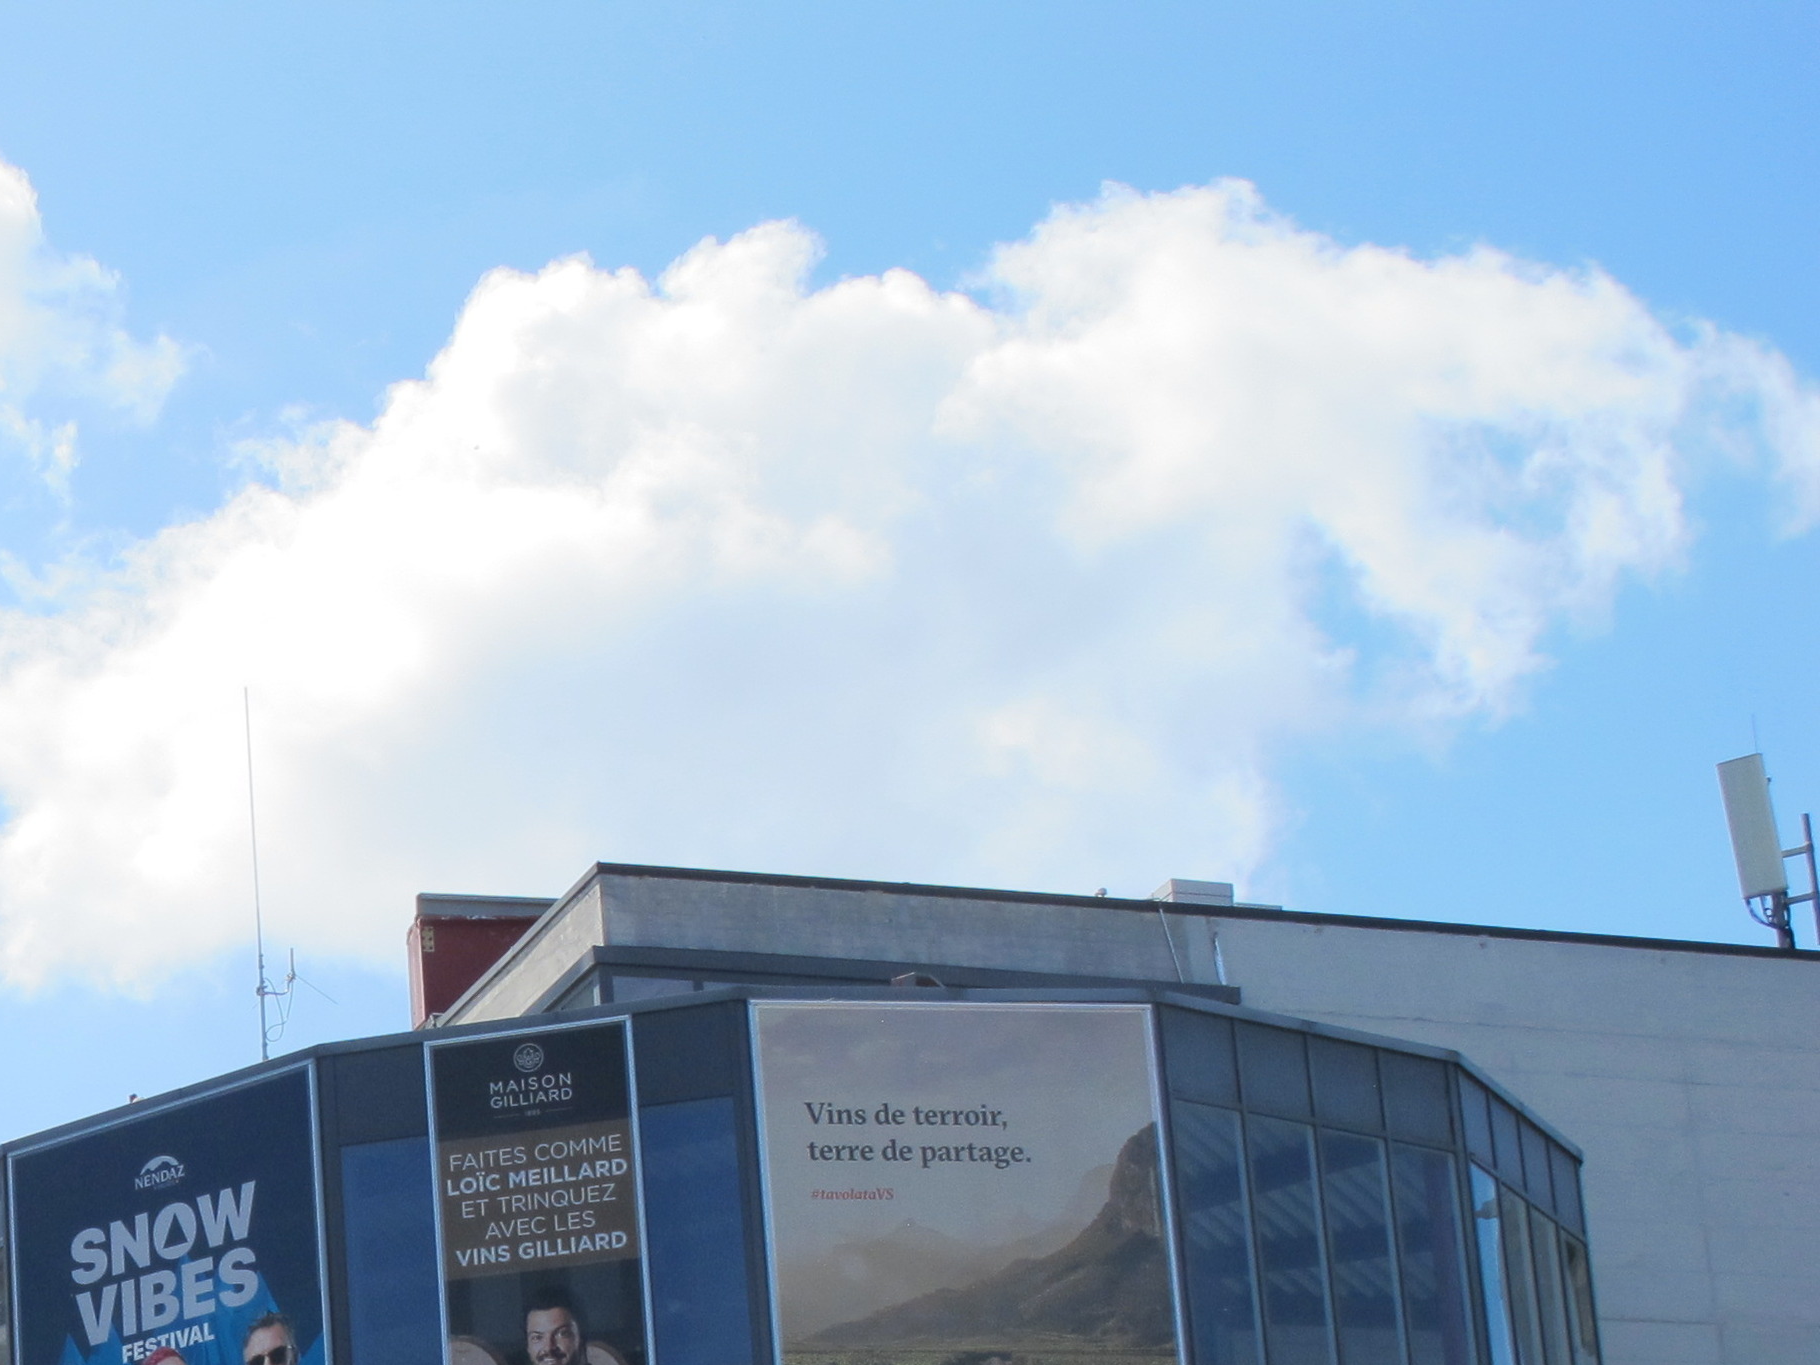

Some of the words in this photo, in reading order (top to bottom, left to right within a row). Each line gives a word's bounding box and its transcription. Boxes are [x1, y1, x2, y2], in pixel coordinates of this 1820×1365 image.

[490, 1072, 572, 1095] MAISON
[490, 1087, 573, 1109] GILLIARD
[804, 1102, 867, 1126] Vins
[874, 1102, 905, 1126] de
[912, 1104, 1008, 1131] terroir,
[449, 1147, 527, 1173] FAITES
[534, 1134, 622, 1162] COMME
[807, 1140, 874, 1162] terre
[881, 1138, 913, 1162] de
[919, 1141, 1032, 1170] partage.
[134, 1164, 185, 1190] NENDAZ
[447, 1172, 500, 1197] LOÏC
[509, 1158, 627, 1189] MEILLARD
[461, 1199, 489, 1219] ET
[497, 1183, 616, 1214] TRINQUEZ
[70, 1180, 256, 1285] SNOW
[485, 1216, 546, 1240] AVEC
[554, 1210, 596, 1232] LES
[456, 1245, 511, 1268] VINS
[518, 1231, 627, 1260] GILLIARD
[75, 1248, 259, 1347] VIBES
[122, 1322, 215, 1365] FESTIVAL
